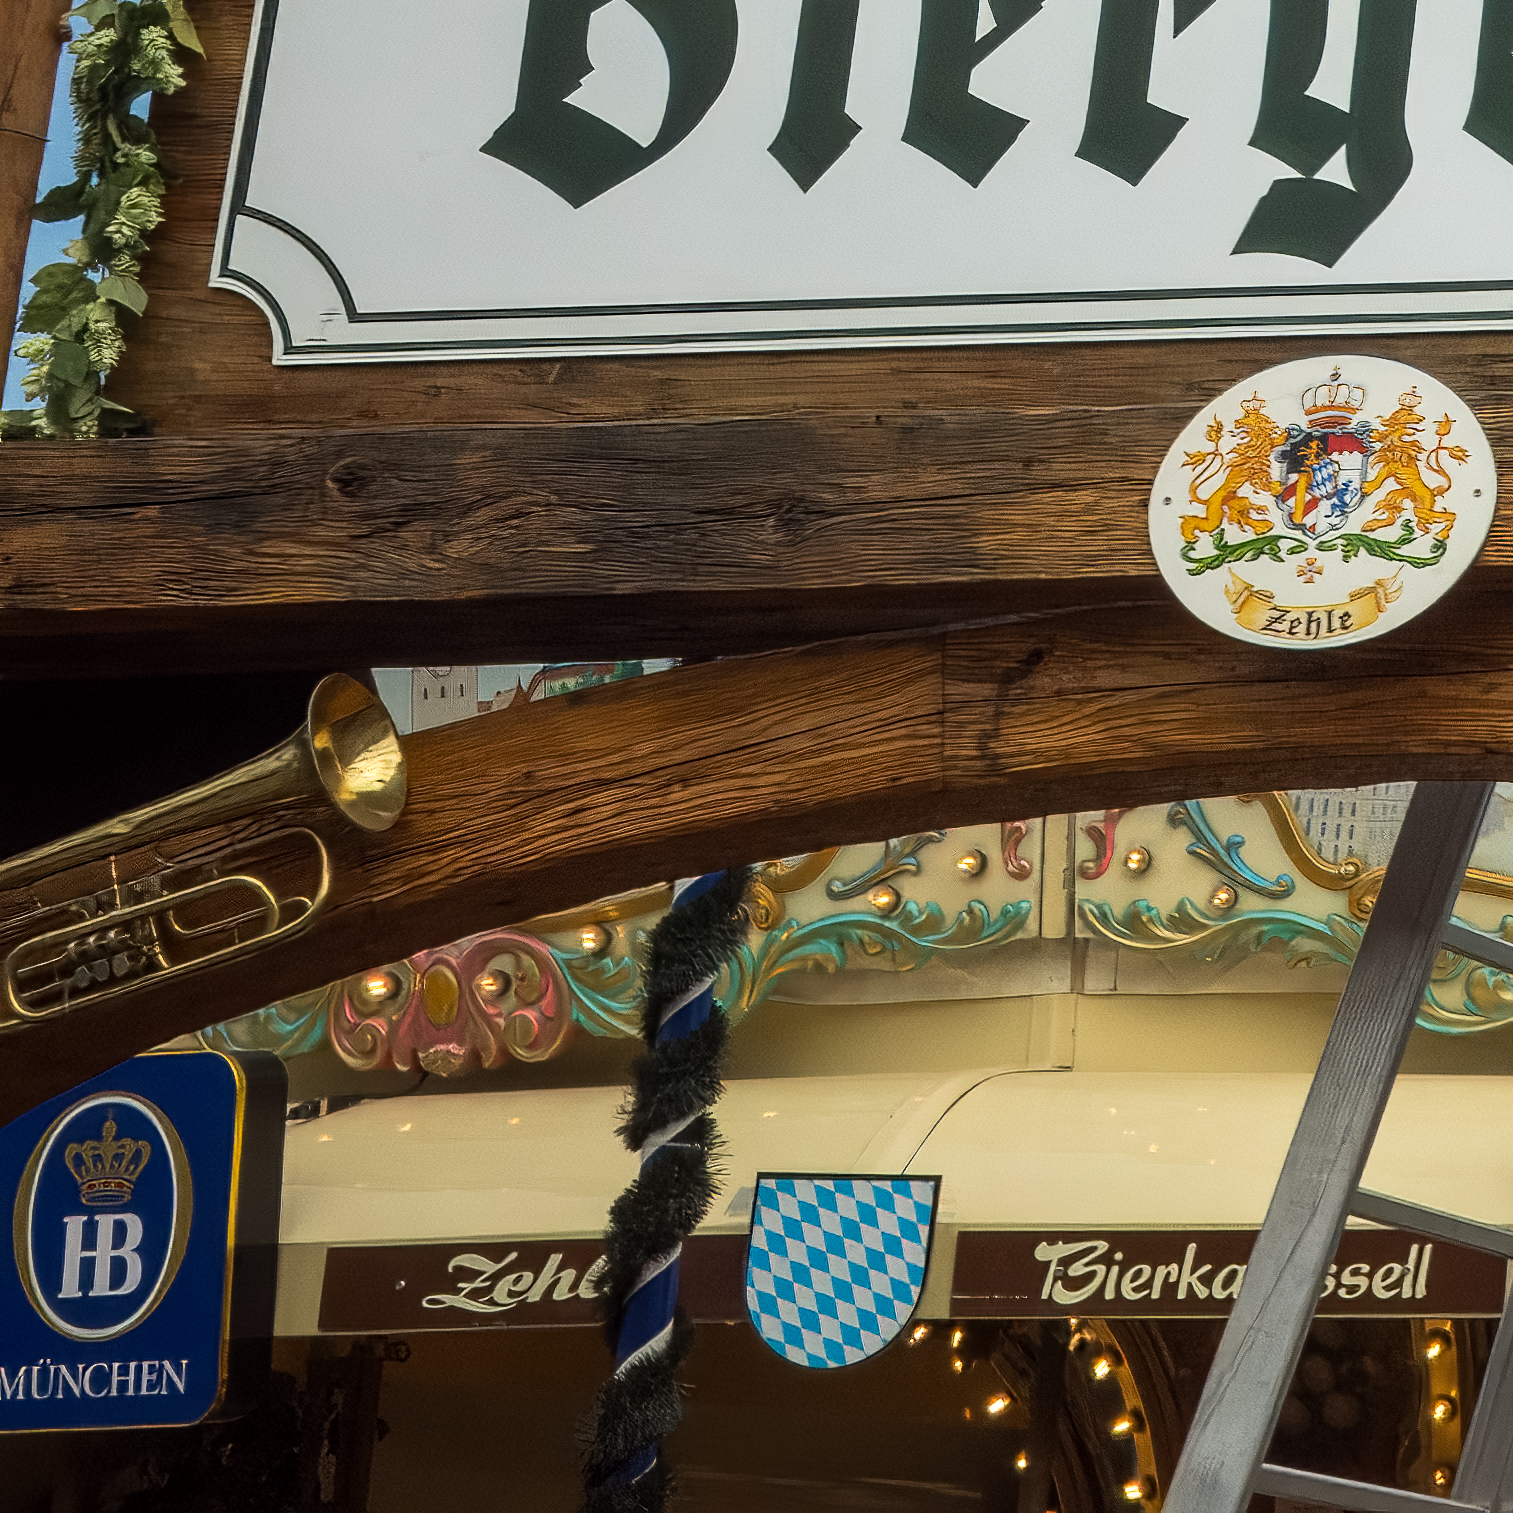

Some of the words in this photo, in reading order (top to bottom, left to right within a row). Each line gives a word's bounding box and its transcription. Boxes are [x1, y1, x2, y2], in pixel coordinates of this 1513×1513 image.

[1259, 606, 1356, 641] Zehle
[57, 1212, 144, 1300] HB
[421, 1251, 608, 1313] Zehl
[1033, 1239, 1433, 1305] Bierkassell
[0, 1357, 189, 1401] MÜNCHEN
